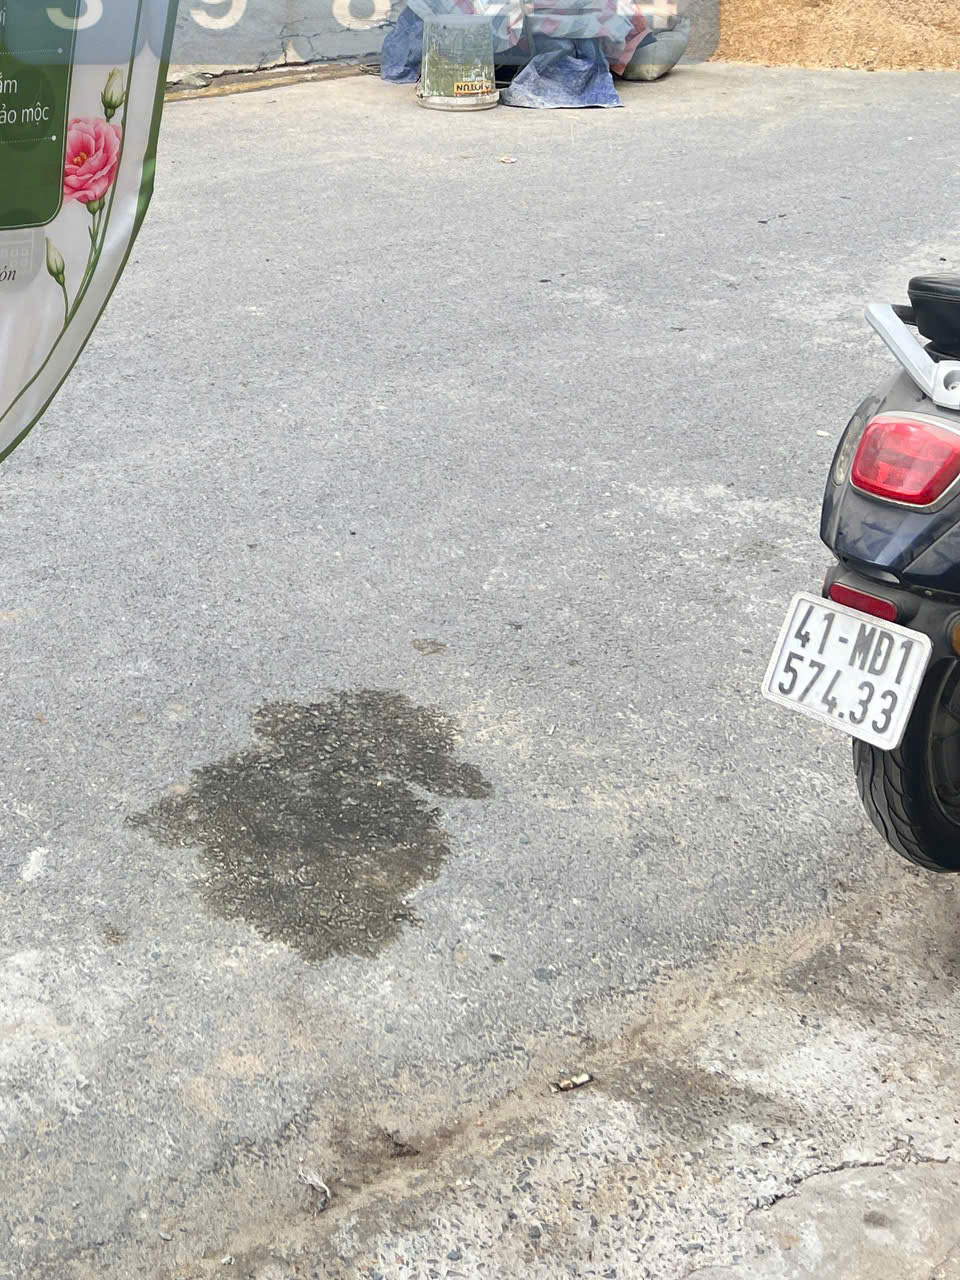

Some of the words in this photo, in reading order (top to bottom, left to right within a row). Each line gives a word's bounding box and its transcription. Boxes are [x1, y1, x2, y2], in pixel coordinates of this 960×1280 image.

[21, 102, 49, 126] mộc
[794, 605, 913, 684] 41-MĐ1
[778, 652, 898, 734] 574.33
